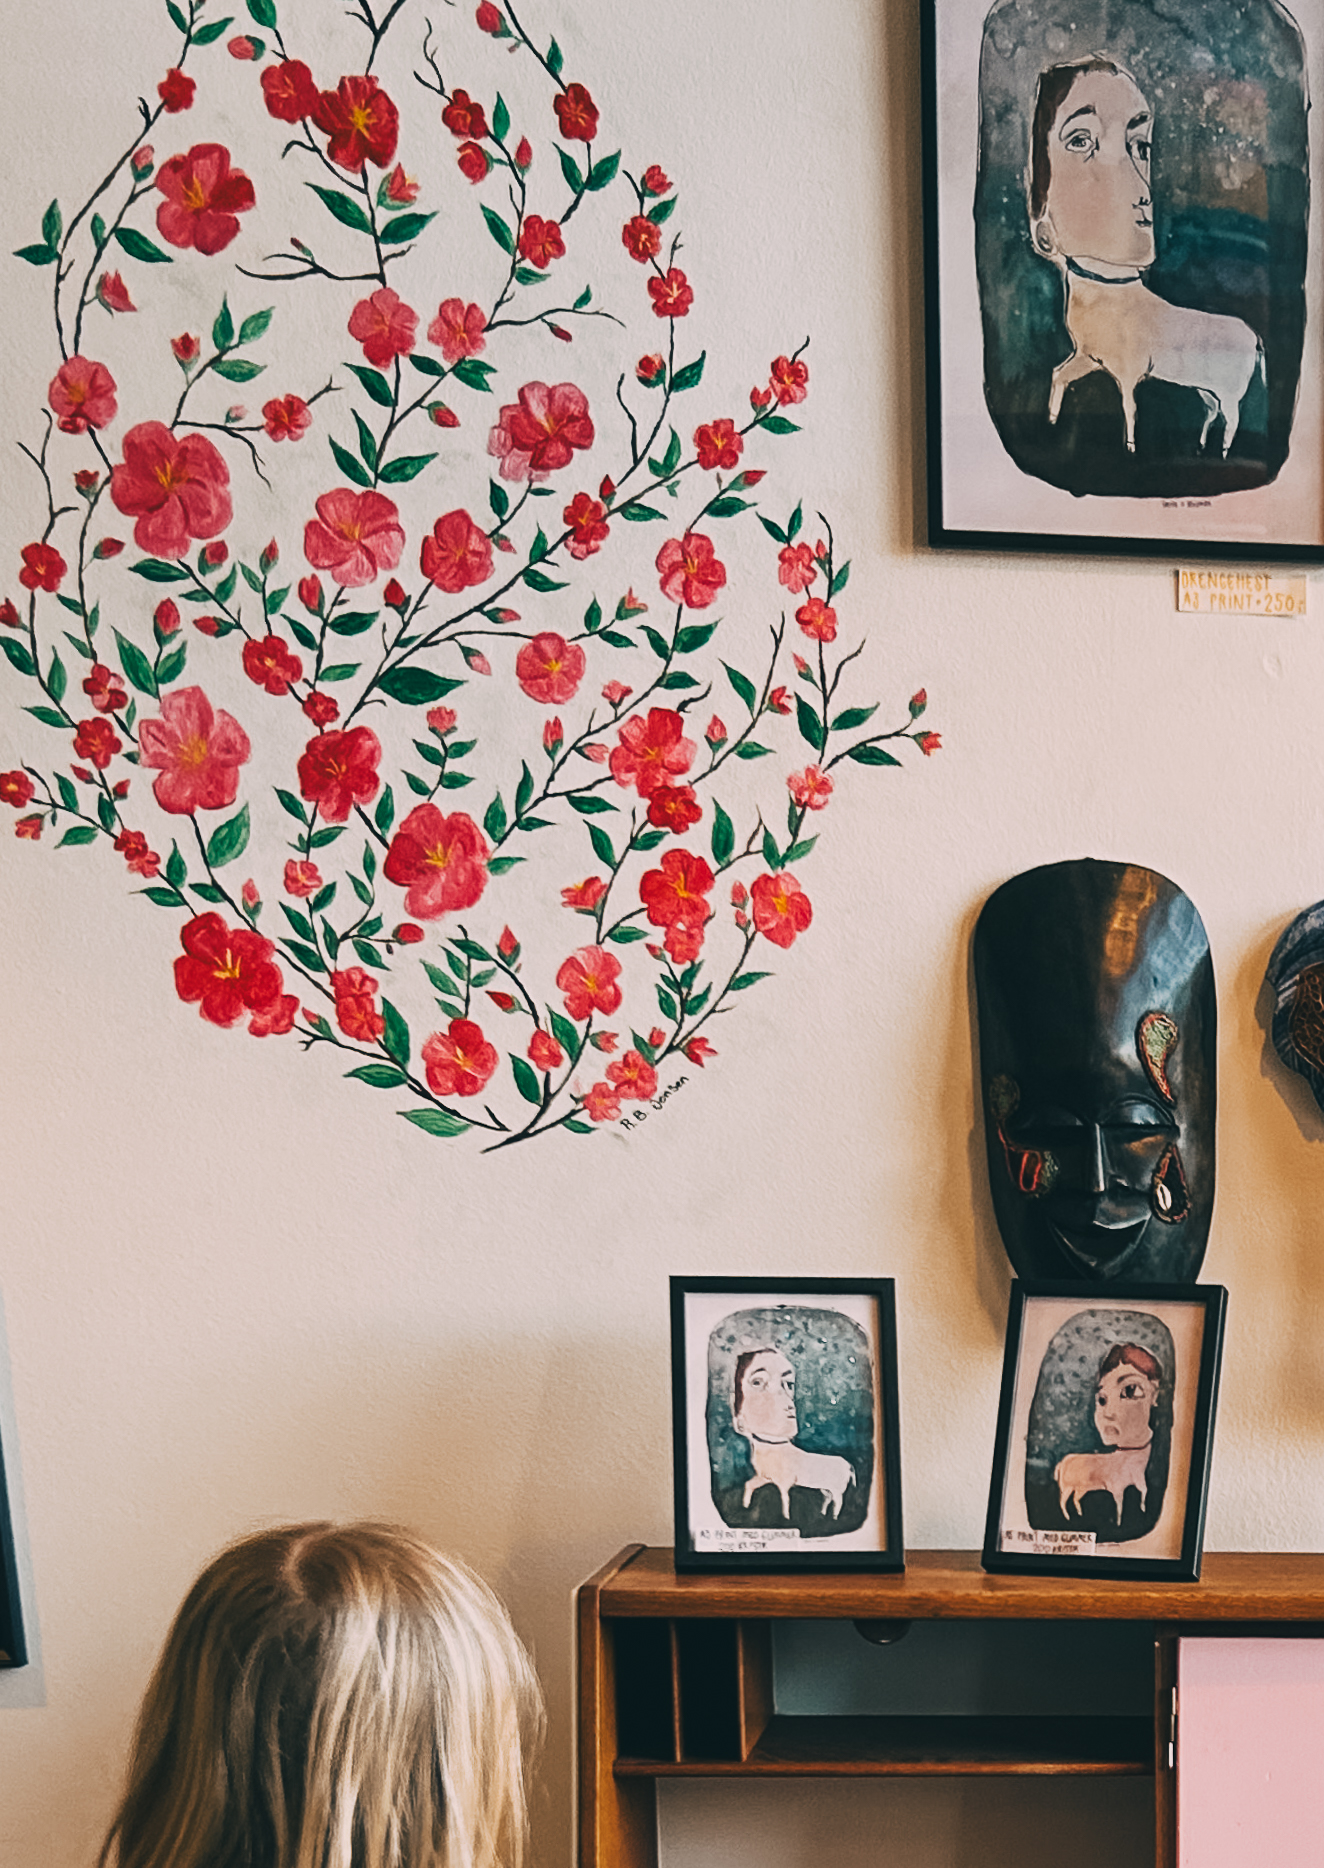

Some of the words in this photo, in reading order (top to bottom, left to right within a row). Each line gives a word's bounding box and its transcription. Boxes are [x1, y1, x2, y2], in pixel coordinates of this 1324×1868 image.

[1181, 570, 1271, 592] DRENGEHEST
[1183, 591, 1199, 610] A3
[1209, 593, 1253, 612] PRINT
